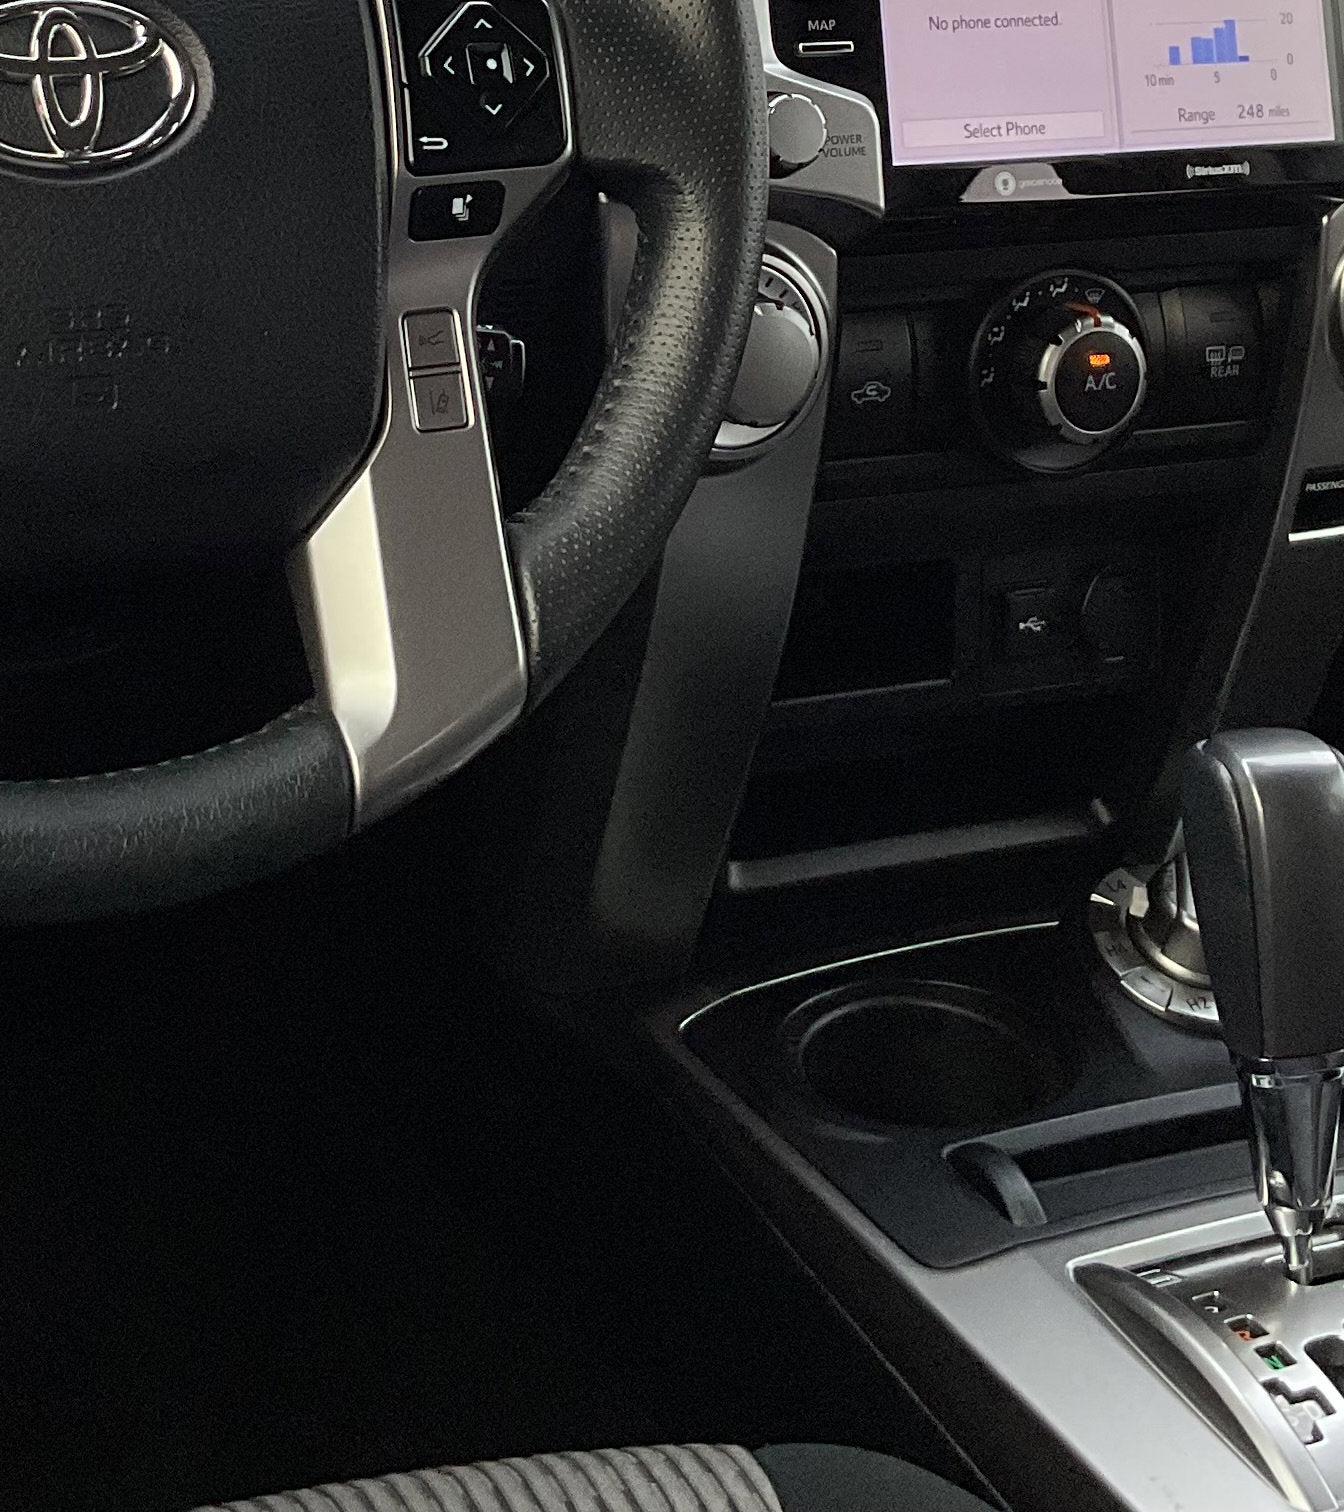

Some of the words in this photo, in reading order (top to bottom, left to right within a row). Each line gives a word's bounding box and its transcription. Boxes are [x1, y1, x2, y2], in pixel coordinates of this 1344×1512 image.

[807, 19, 836, 31] MAP
[928, 15, 949, 31] No
[952, 14, 991, 33] phone
[994, 10, 1063, 29] connected.
[1280, 12, 1293, 25] 20
[1286, 52, 1294, 65] 0
[1144, 74, 1157, 87] 10
[1158, 75, 1175, 86] min
[1213, 71, 1221, 84] 5
[1270, 68, 1278, 81] 0
[1177, 107, 1216, 124] Range
[1237, 103, 1264, 119] 248
[1268, 105, 1290, 118] miles
[963, 123, 1003, 139] Select
[1005, 121, 1046, 136] Phone
[824, 134, 863, 145] POWER
[822, 145, 867, 158] VOLUME
[1209, 364, 1241, 379] REAR
[1084, 372, 1117, 392] A/C
[1186, 996, 1214, 1012] H2
